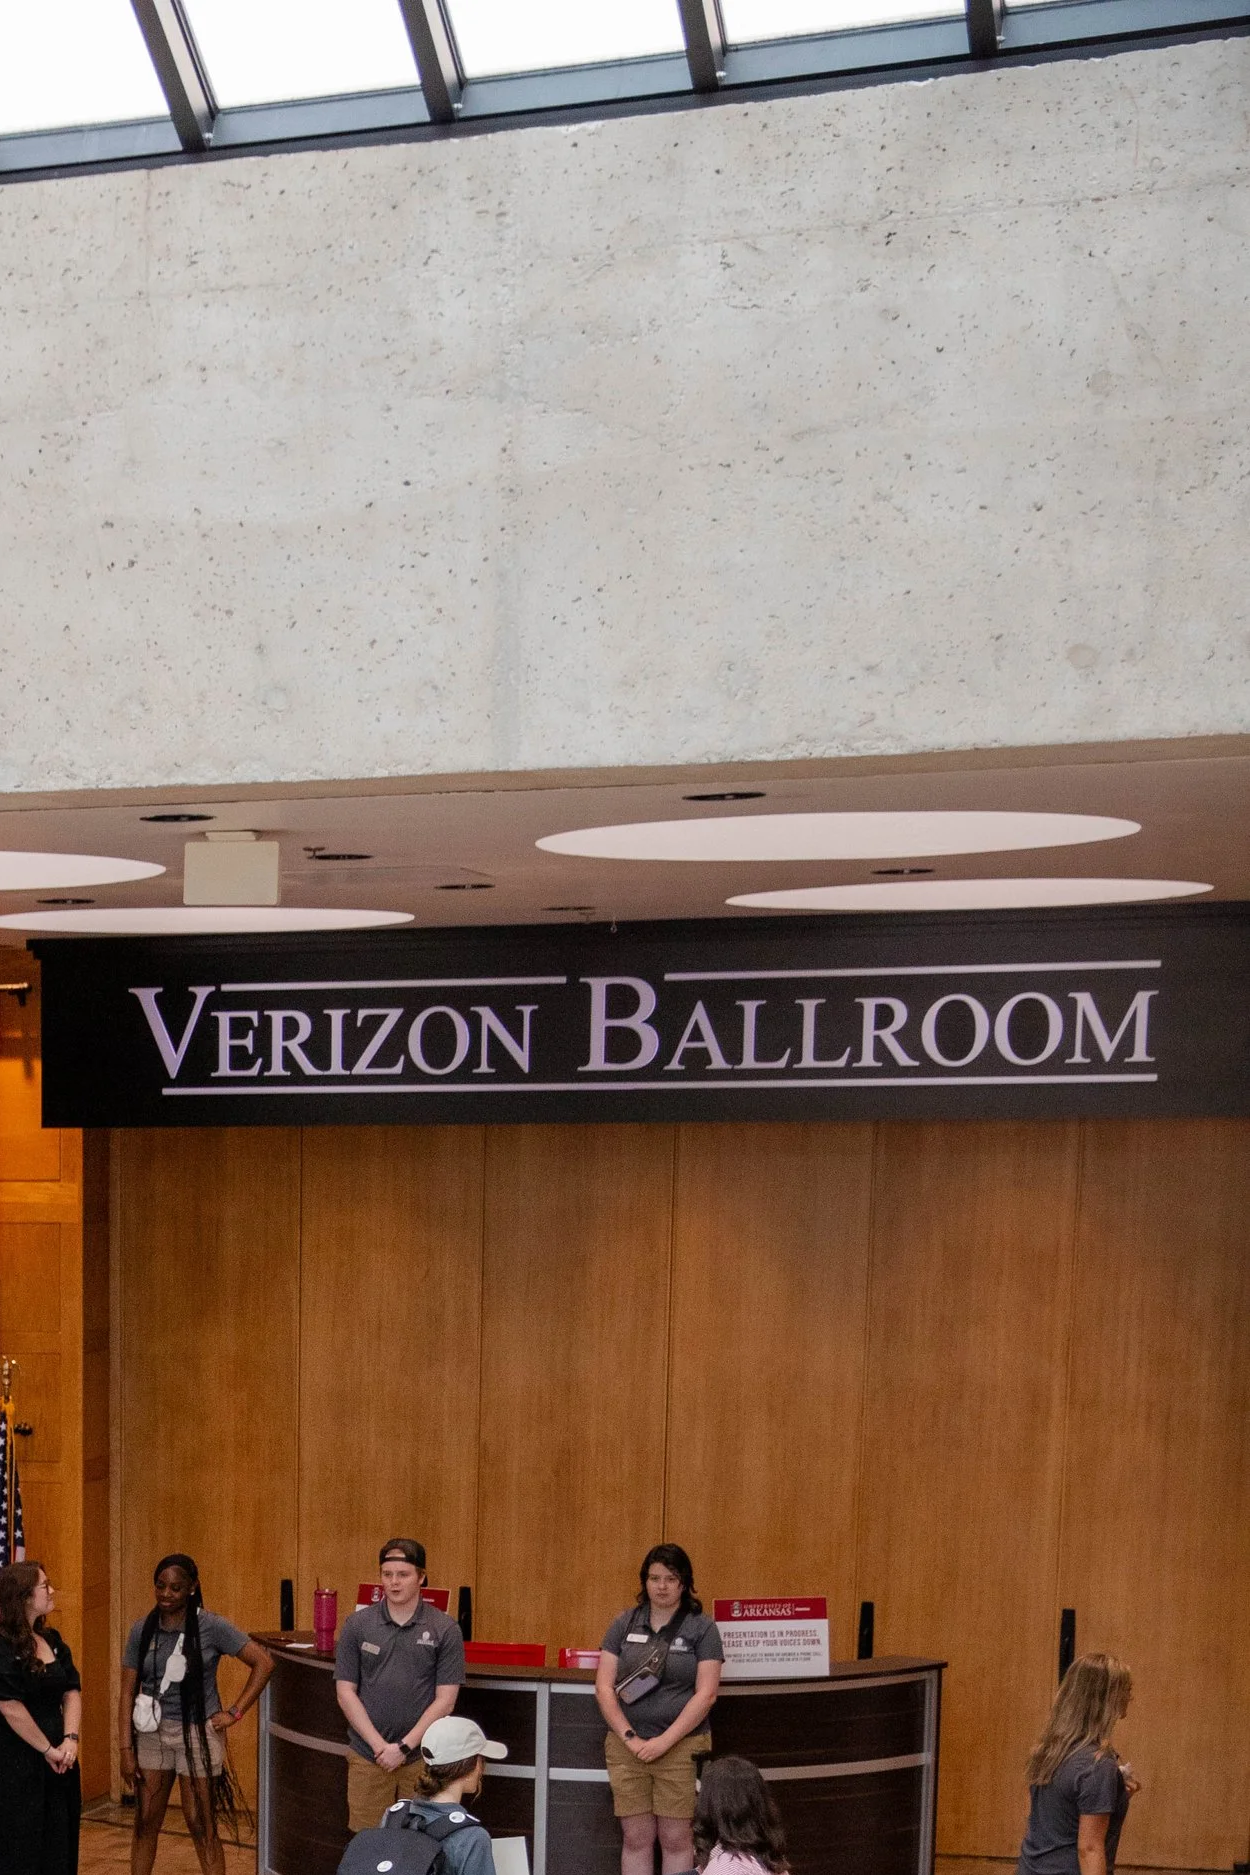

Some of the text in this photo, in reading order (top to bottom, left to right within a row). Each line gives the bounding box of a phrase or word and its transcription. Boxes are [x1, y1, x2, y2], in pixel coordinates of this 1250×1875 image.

[128, 975, 1159, 1080] VERIZON BALLROOM
[743, 1608, 791, 1617] ARKANSAS
[724, 1630, 768, 1639] PRESENTATION
